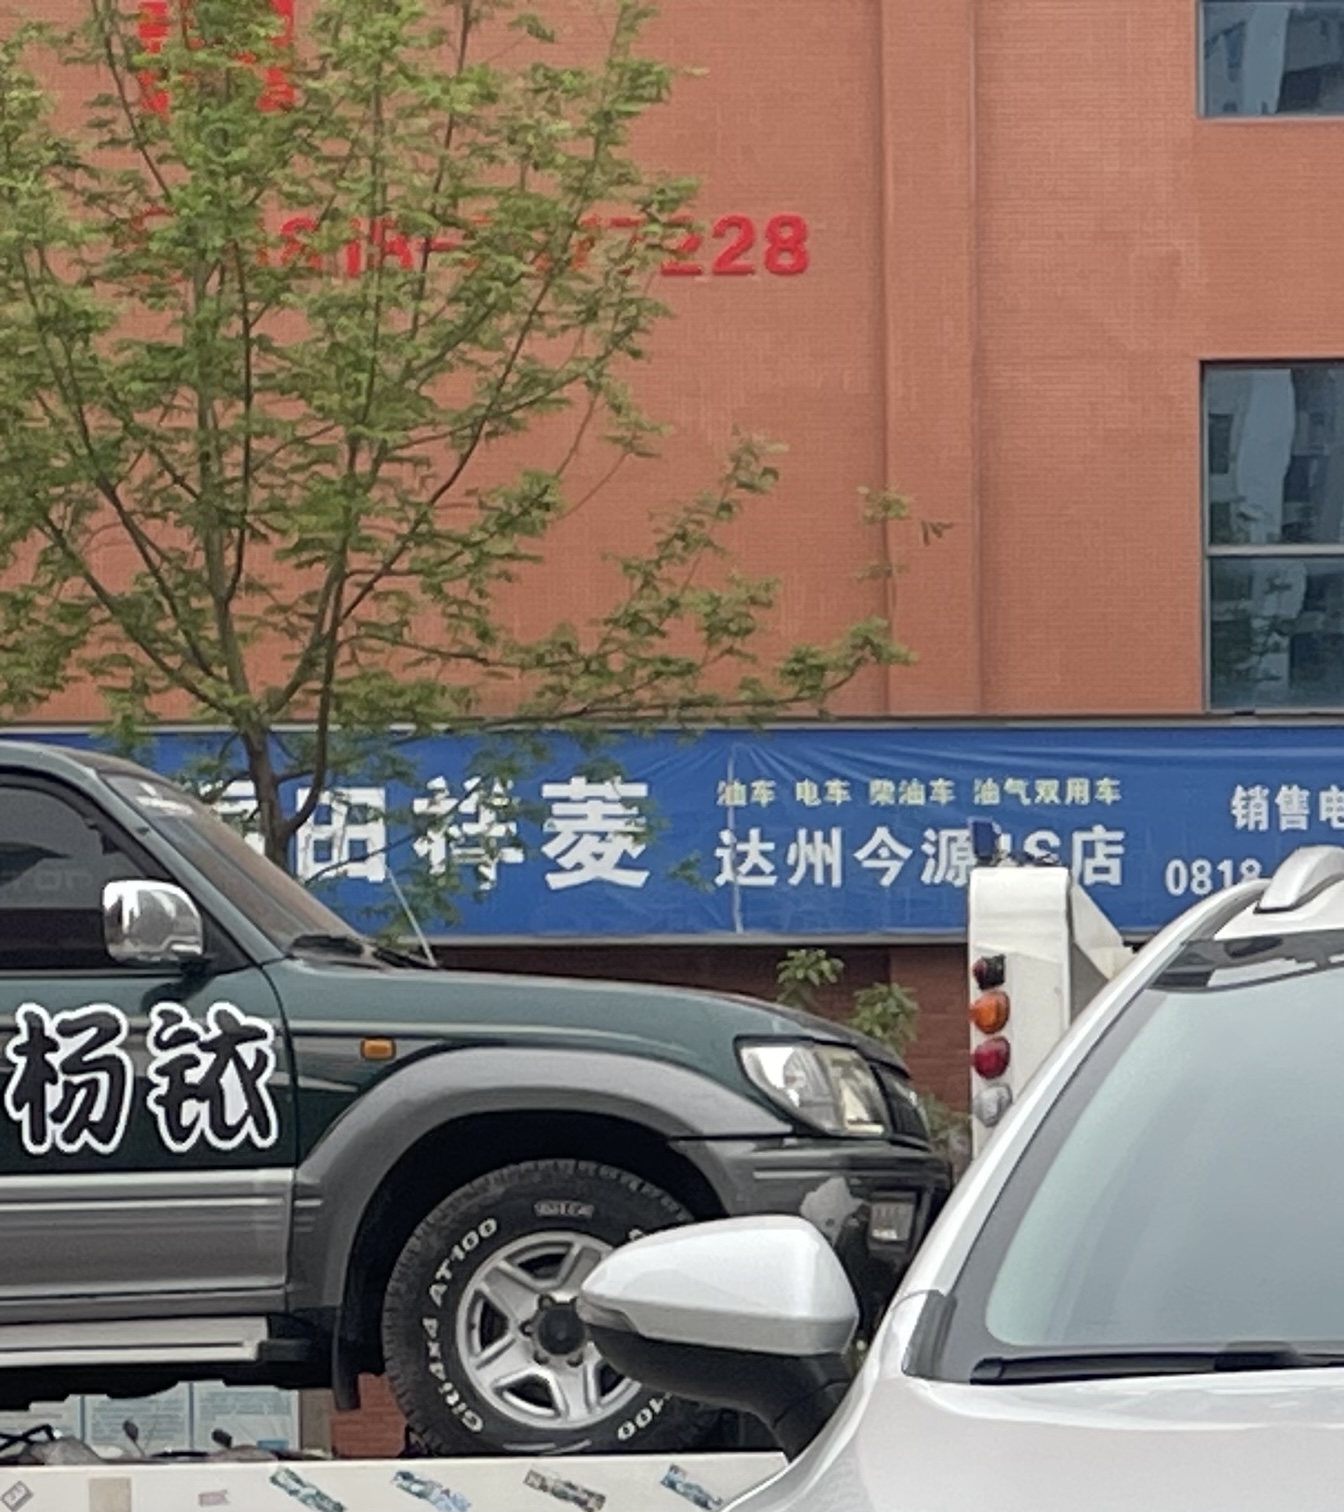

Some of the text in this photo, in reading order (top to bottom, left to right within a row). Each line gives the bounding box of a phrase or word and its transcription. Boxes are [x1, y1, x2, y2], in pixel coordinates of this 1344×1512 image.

[716, 779, 776, 807] 油车
[795, 779, 851, 807] 电车
[973, 777, 1122, 807] 油气双用车
